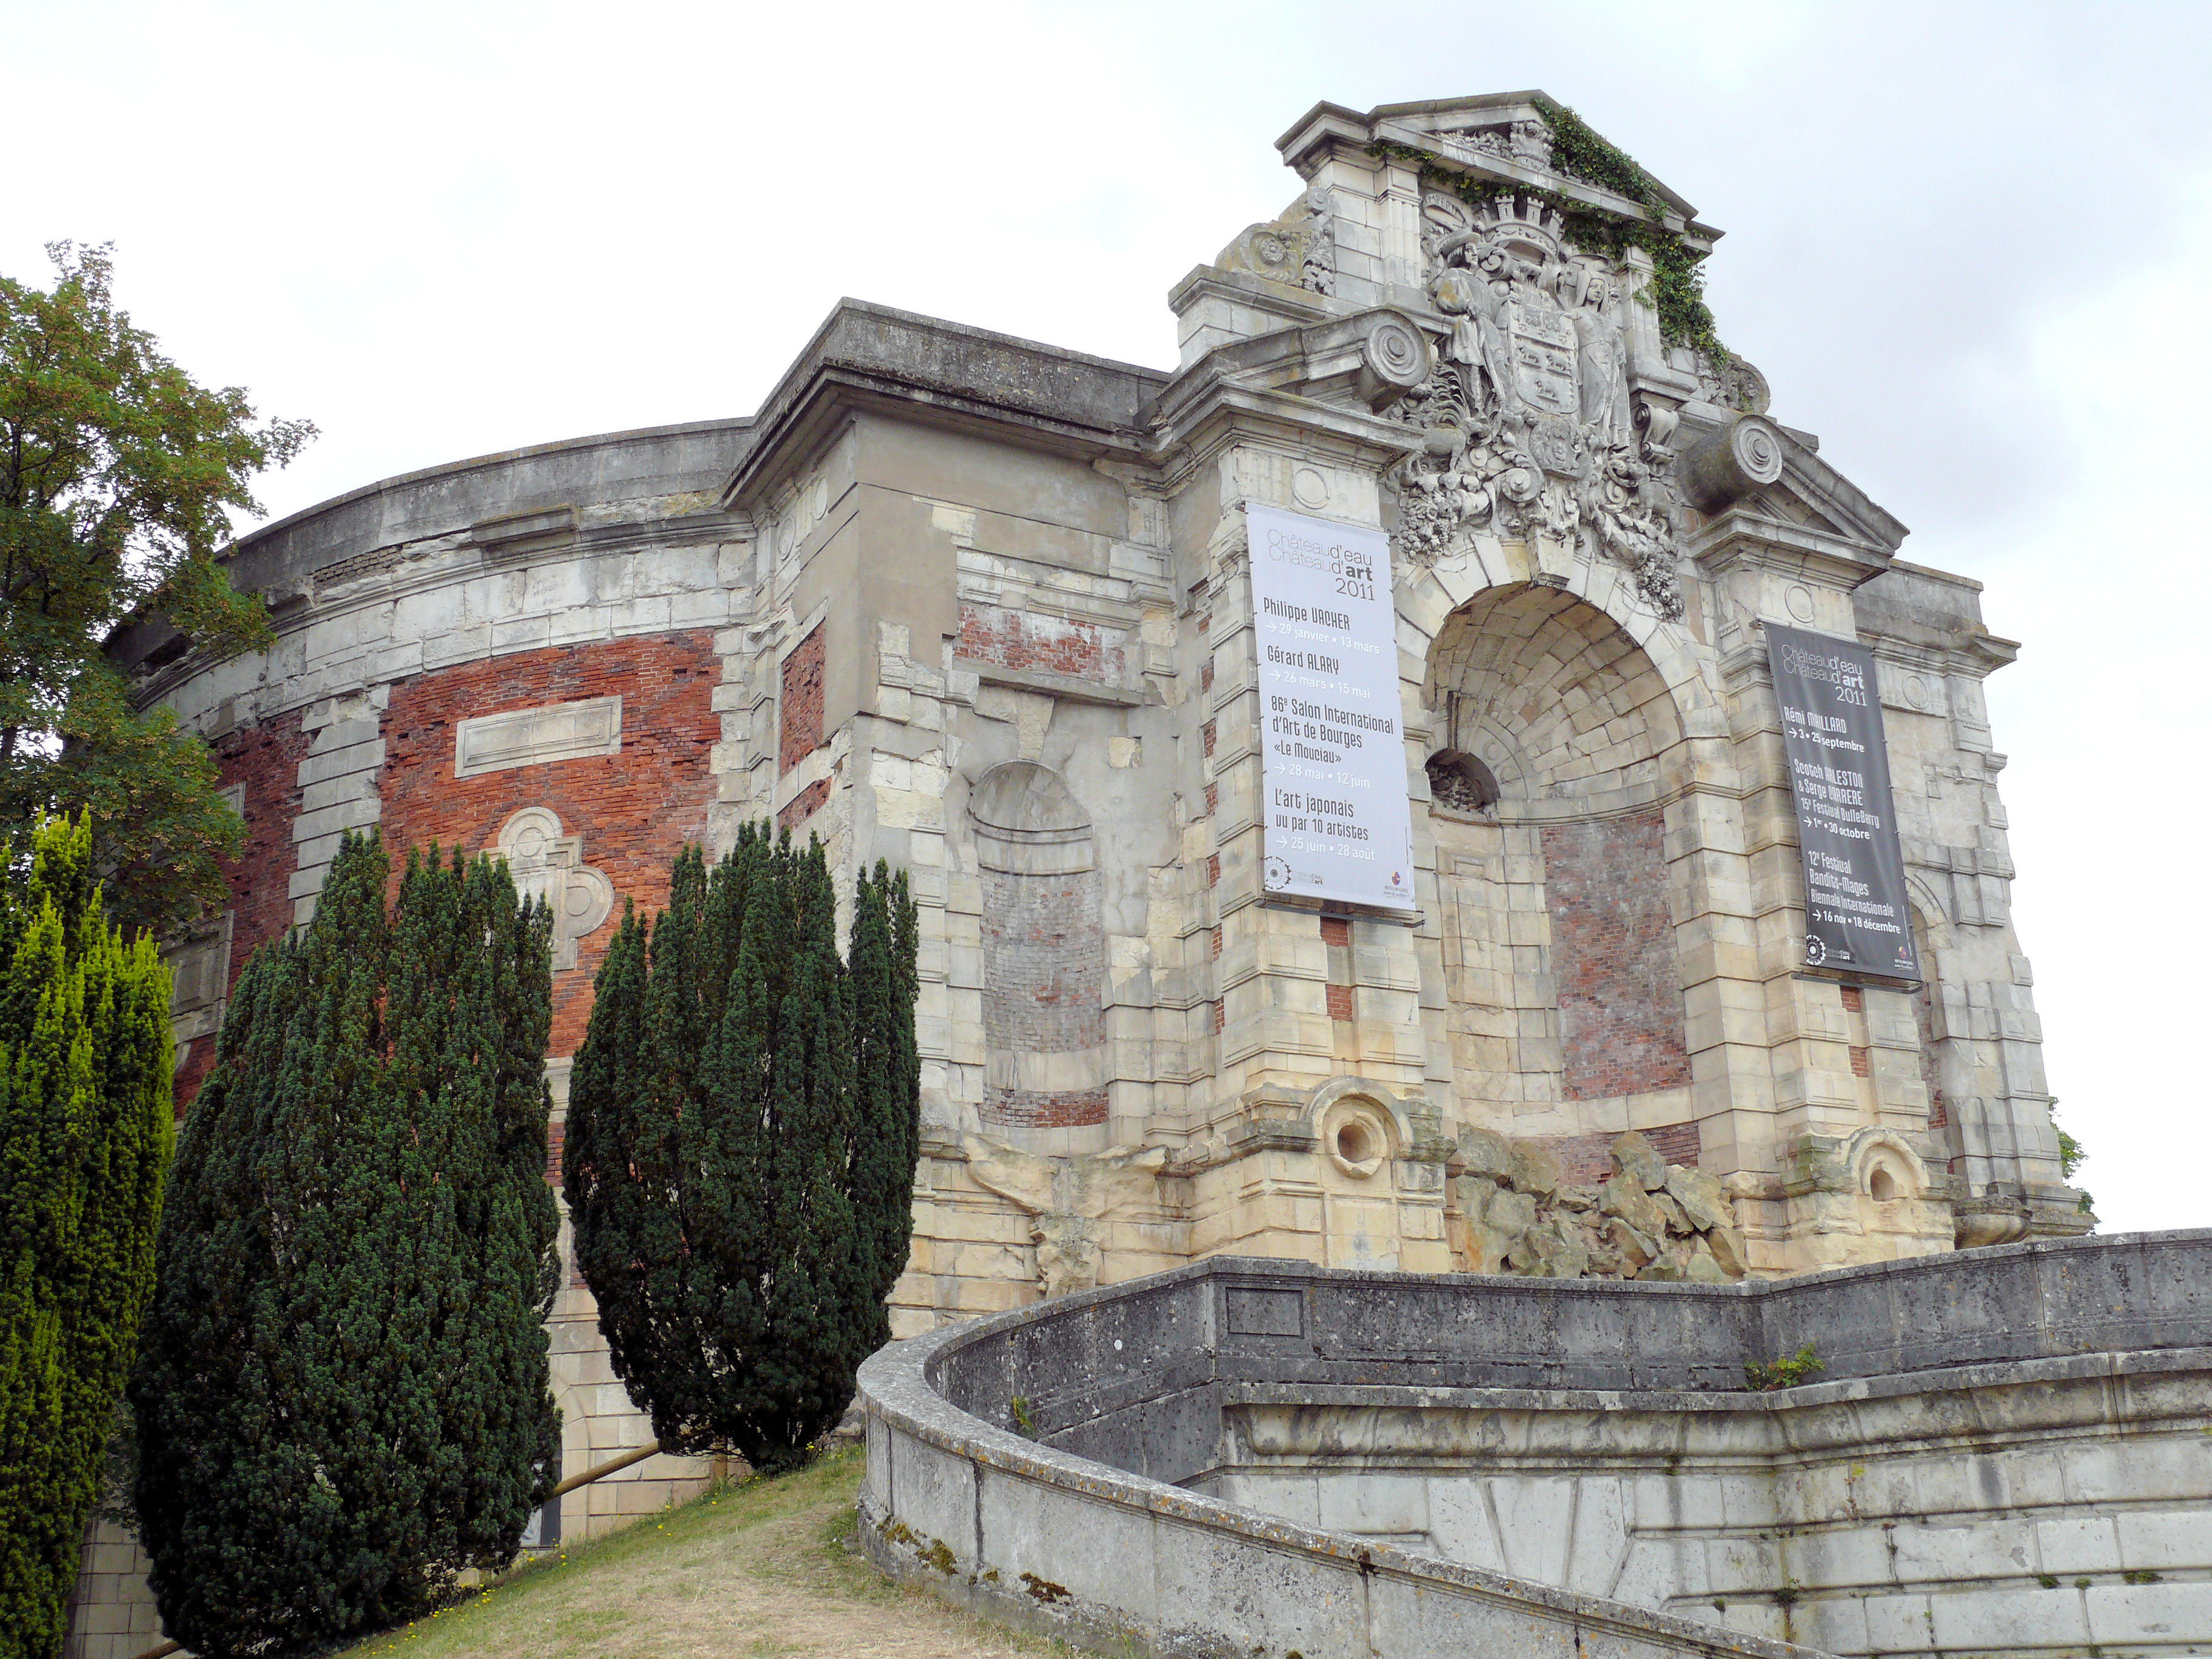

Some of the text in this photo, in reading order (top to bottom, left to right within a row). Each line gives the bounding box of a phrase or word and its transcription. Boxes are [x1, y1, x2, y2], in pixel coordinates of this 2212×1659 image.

[1335, 578, 1375, 601] 2011
[1263, 597, 1307, 623] Philippe
[1279, 623, 1380, 654] 29 janvier 13 mars
[1267, 645, 1339, 675] Gérard ALARY
[1284, 671, 1370, 699] 26 mars 15 mai
[1835, 686, 1867, 706] 2011
[1292, 699, 1321, 719] Salon
[1324, 704, 1393, 734] International
[1784, 706, 1847, 734] Rémi MAILLARD
[1273, 716, 1362, 748] d'Art de Bourges
[1798, 729, 1865, 752] 3 25 septembre
[1289, 763, 1370, 788] 28 mai 12 juin
[1794, 759, 1863, 789] Scotch ARLESTON
[1275, 788, 1354, 818] L'art japonais
[1798, 780, 1804, 793] &
[1804, 779, 1827, 800] Serge
[1292, 816, 1307, 832] par
[1312, 818, 1322, 834] 10
[1327, 822, 1369, 840] artistes
[1812, 799, 1840, 819] Festival
[1840, 807, 1880, 830] BulleBerry
[1828, 822, 1838, 834] 30
[1839, 827, 1870, 840] octobre
[1291, 837, 1375, 861] 25 juin 28 août
[1820, 852, 1852, 875] Festival
[1809, 868, 1869, 897] Bandits-Mages
[1811, 888, 1894, 917] Biennale Internationale
[1823, 910, 1832, 922] 16
[1853, 916, 1863, 928] 18
[1863, 918, 1900, 934] décembre
